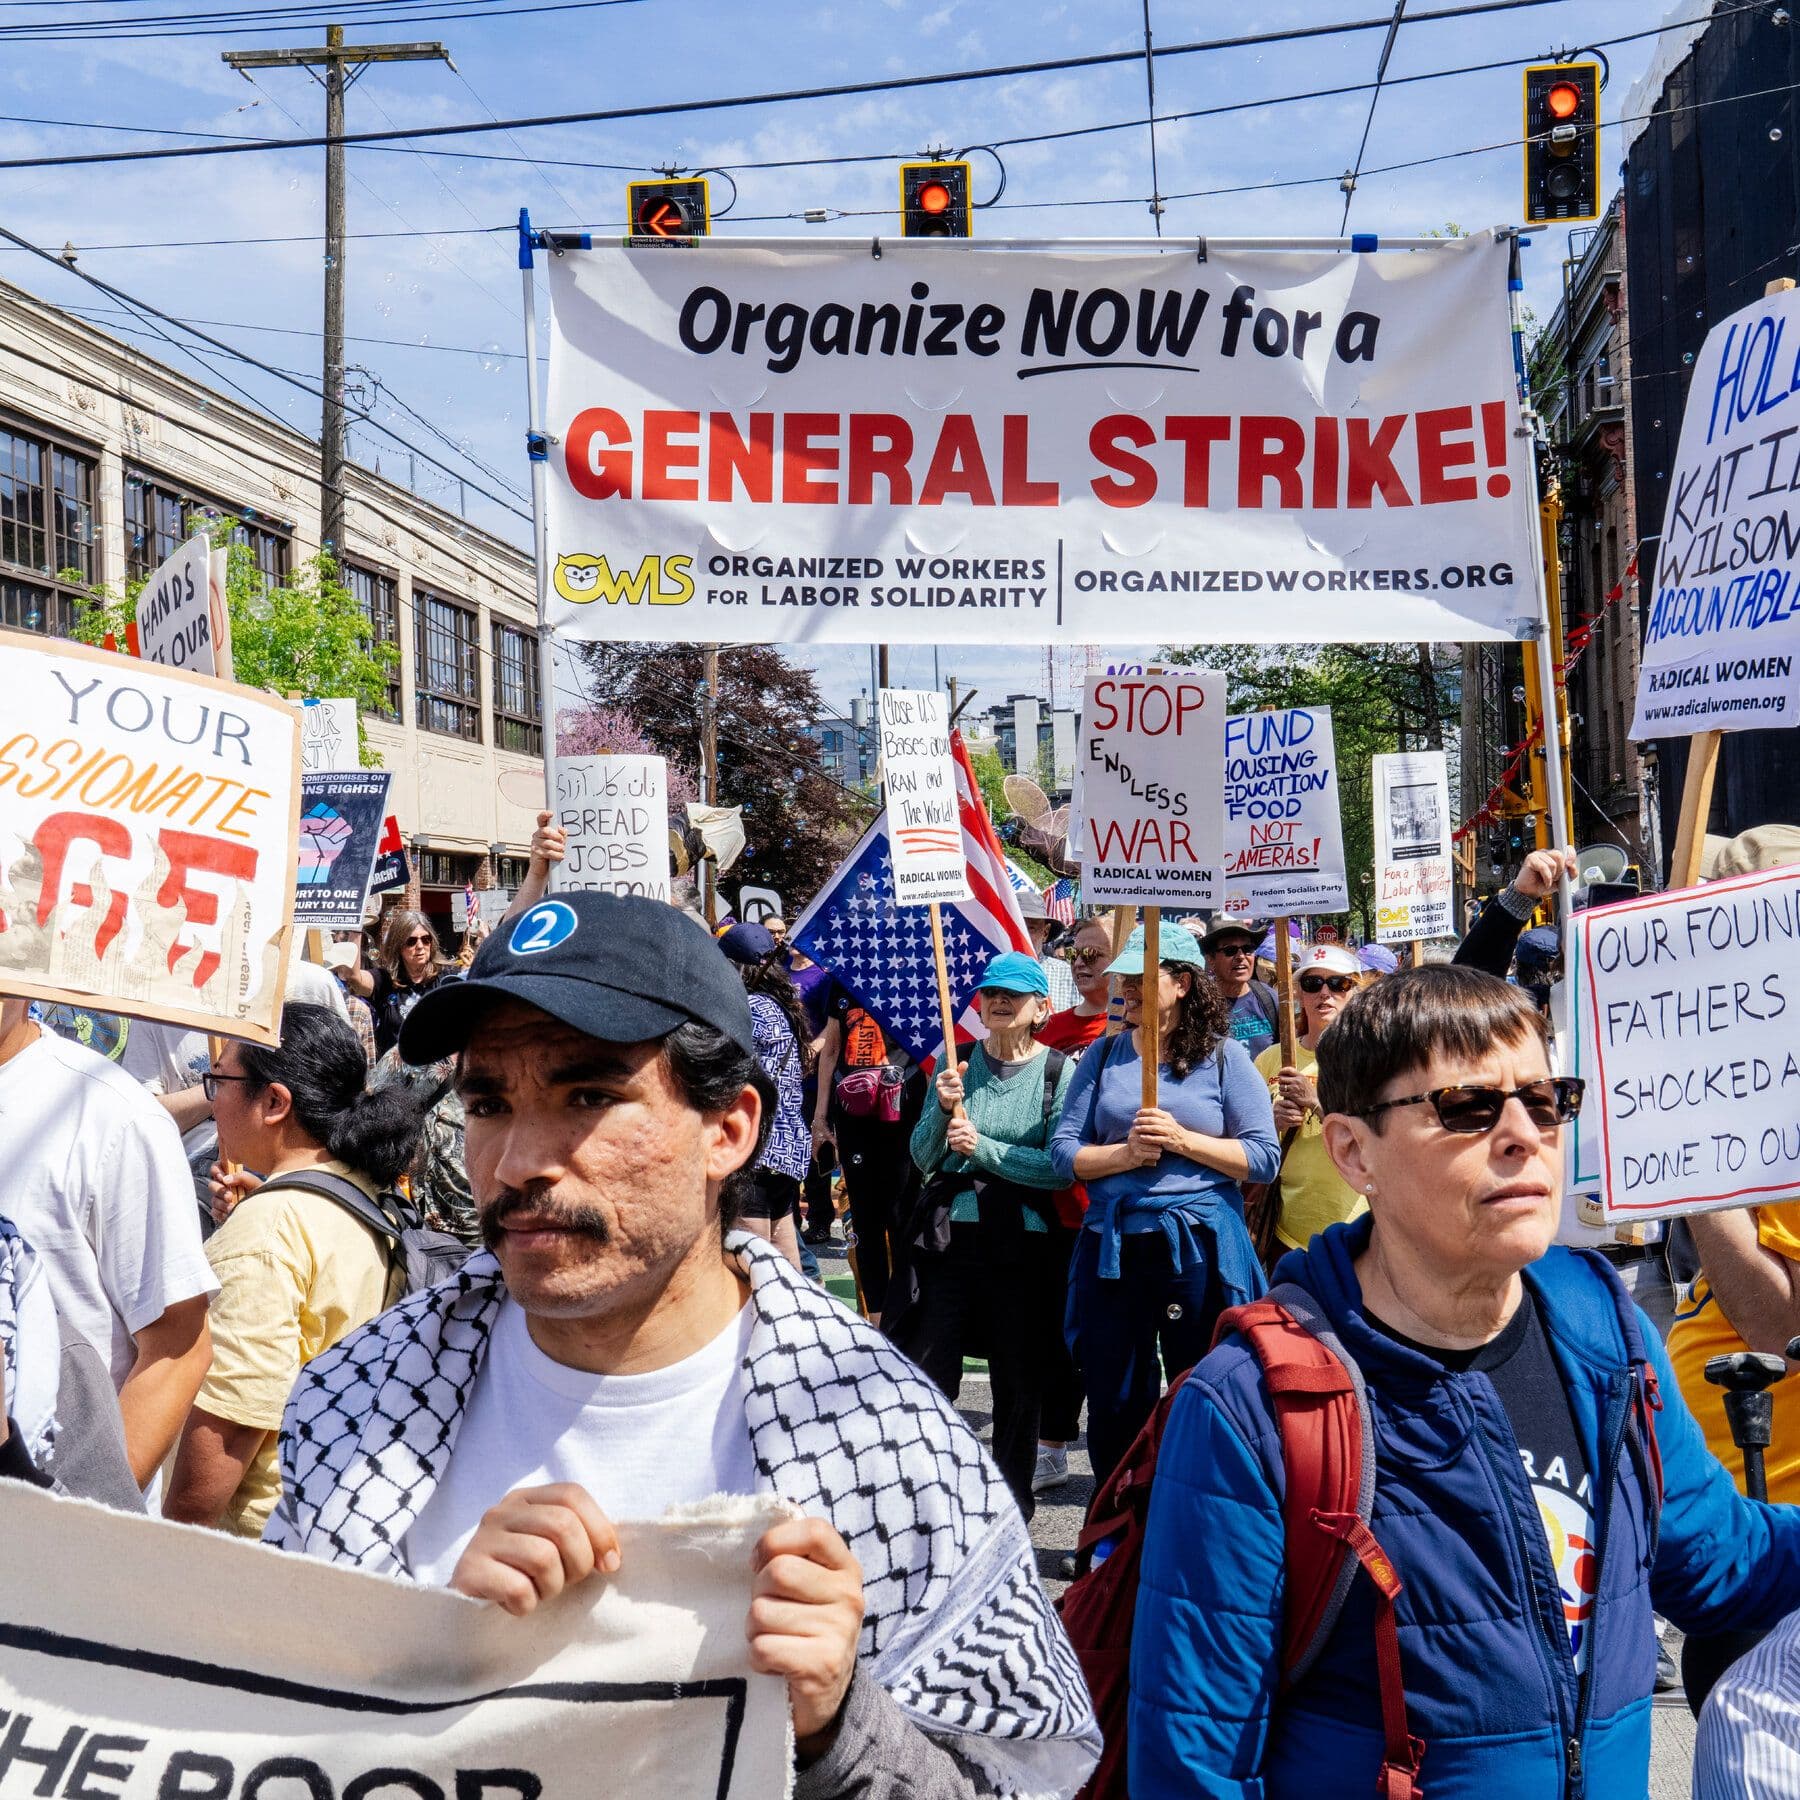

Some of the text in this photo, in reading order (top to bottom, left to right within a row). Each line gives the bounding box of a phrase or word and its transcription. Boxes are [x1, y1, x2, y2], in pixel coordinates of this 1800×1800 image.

[679, 282, 1380, 373] Organize NOW for a
[565, 400, 1511, 509] GENERAL STRIKE!
[1658, 509, 1800, 588] WILSON
[708, 555, 1046, 580] ORGANIZED WORKERS
[1074, 563, 1513, 593] ORGANIZEDWORKERS.ORG
[142, 562, 195, 650] HANDS
[707, 585, 1047, 608] FOR LABOR SOLIDARITY
[172, 613, 210, 667] OUR
[1649, 656, 1793, 693] RADICAL WOMEN
[50, 670, 252, 766] YOUR
[303, 703, 341, 738] OR
[882, 691, 914, 725] Close
[1093, 681, 1205, 737] STOP
[1645, 695, 1786, 721] www.radicalwomen.org
[884, 731, 928, 759] Bases
[1225, 709, 1314, 758] FUND
[327, 783, 384, 794] RIGHTS!
[1090, 737, 1188, 817] ENDLESS
[1224, 770, 1329, 804] EDUCATION
[561, 808, 649, 837] BREAD
[900, 799, 921, 827] The
[1229, 798, 1301, 821] FOOD
[1090, 818, 1199, 864] WAR
[1250, 821, 1302, 846] NOT
[568, 843, 649, 873] JOBS
[900, 869, 962, 884] RADICAL WOMEN
[1093, 867, 1212, 882] RADICAL WOMEN
[0, 812, 259, 990] GE
[316, 889, 331, 898] TO
[333, 889, 359, 899] ONE
[321, 901, 335, 909] TO
[337, 901, 357, 910] ALL
[1093, 886, 1212, 899] www.radicalwomen.org
[1225, 899, 1250, 912] FSP
[1252, 885, 1343, 897] Freedom Socialist Party
[1410, 902, 1446, 914] ORGANIZED
[1414, 913, 1444, 924] WORKERS
[521, 910, 557, 950] 2
[1318, 932, 1337, 941] STOP
[1386, 929, 1413, 939] LABOR
[1597, 888, 1800, 973] OUR FOUN
[1607, 973, 1786, 1047] FATHERS
[1613, 1058, 1771, 1119] SHOCKED
[1623, 1142, 1701, 1191] DONE
[1711, 1133, 1747, 1173] TO
[0, 1709, 150, 1800] HE
